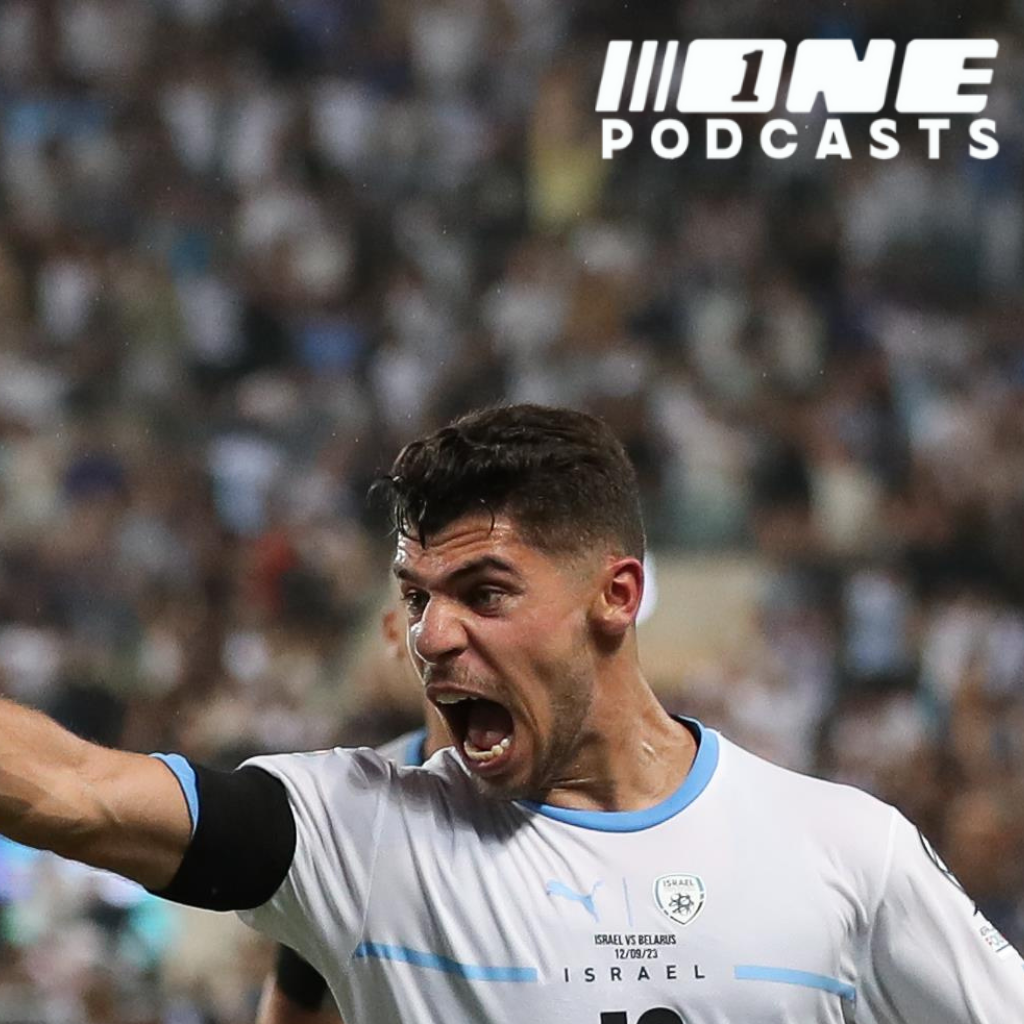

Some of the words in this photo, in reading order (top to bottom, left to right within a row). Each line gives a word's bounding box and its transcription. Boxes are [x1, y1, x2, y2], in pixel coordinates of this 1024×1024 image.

[662, 878, 694, 887] ISRAEL
[594, 934, 623, 946] ISRAEL
[625, 934, 636, 946] VS
[638, 934, 676, 945] BELARUS
[615, 948, 658, 959] 12/09/23
[564, 965, 706, 983] ISRAEL
